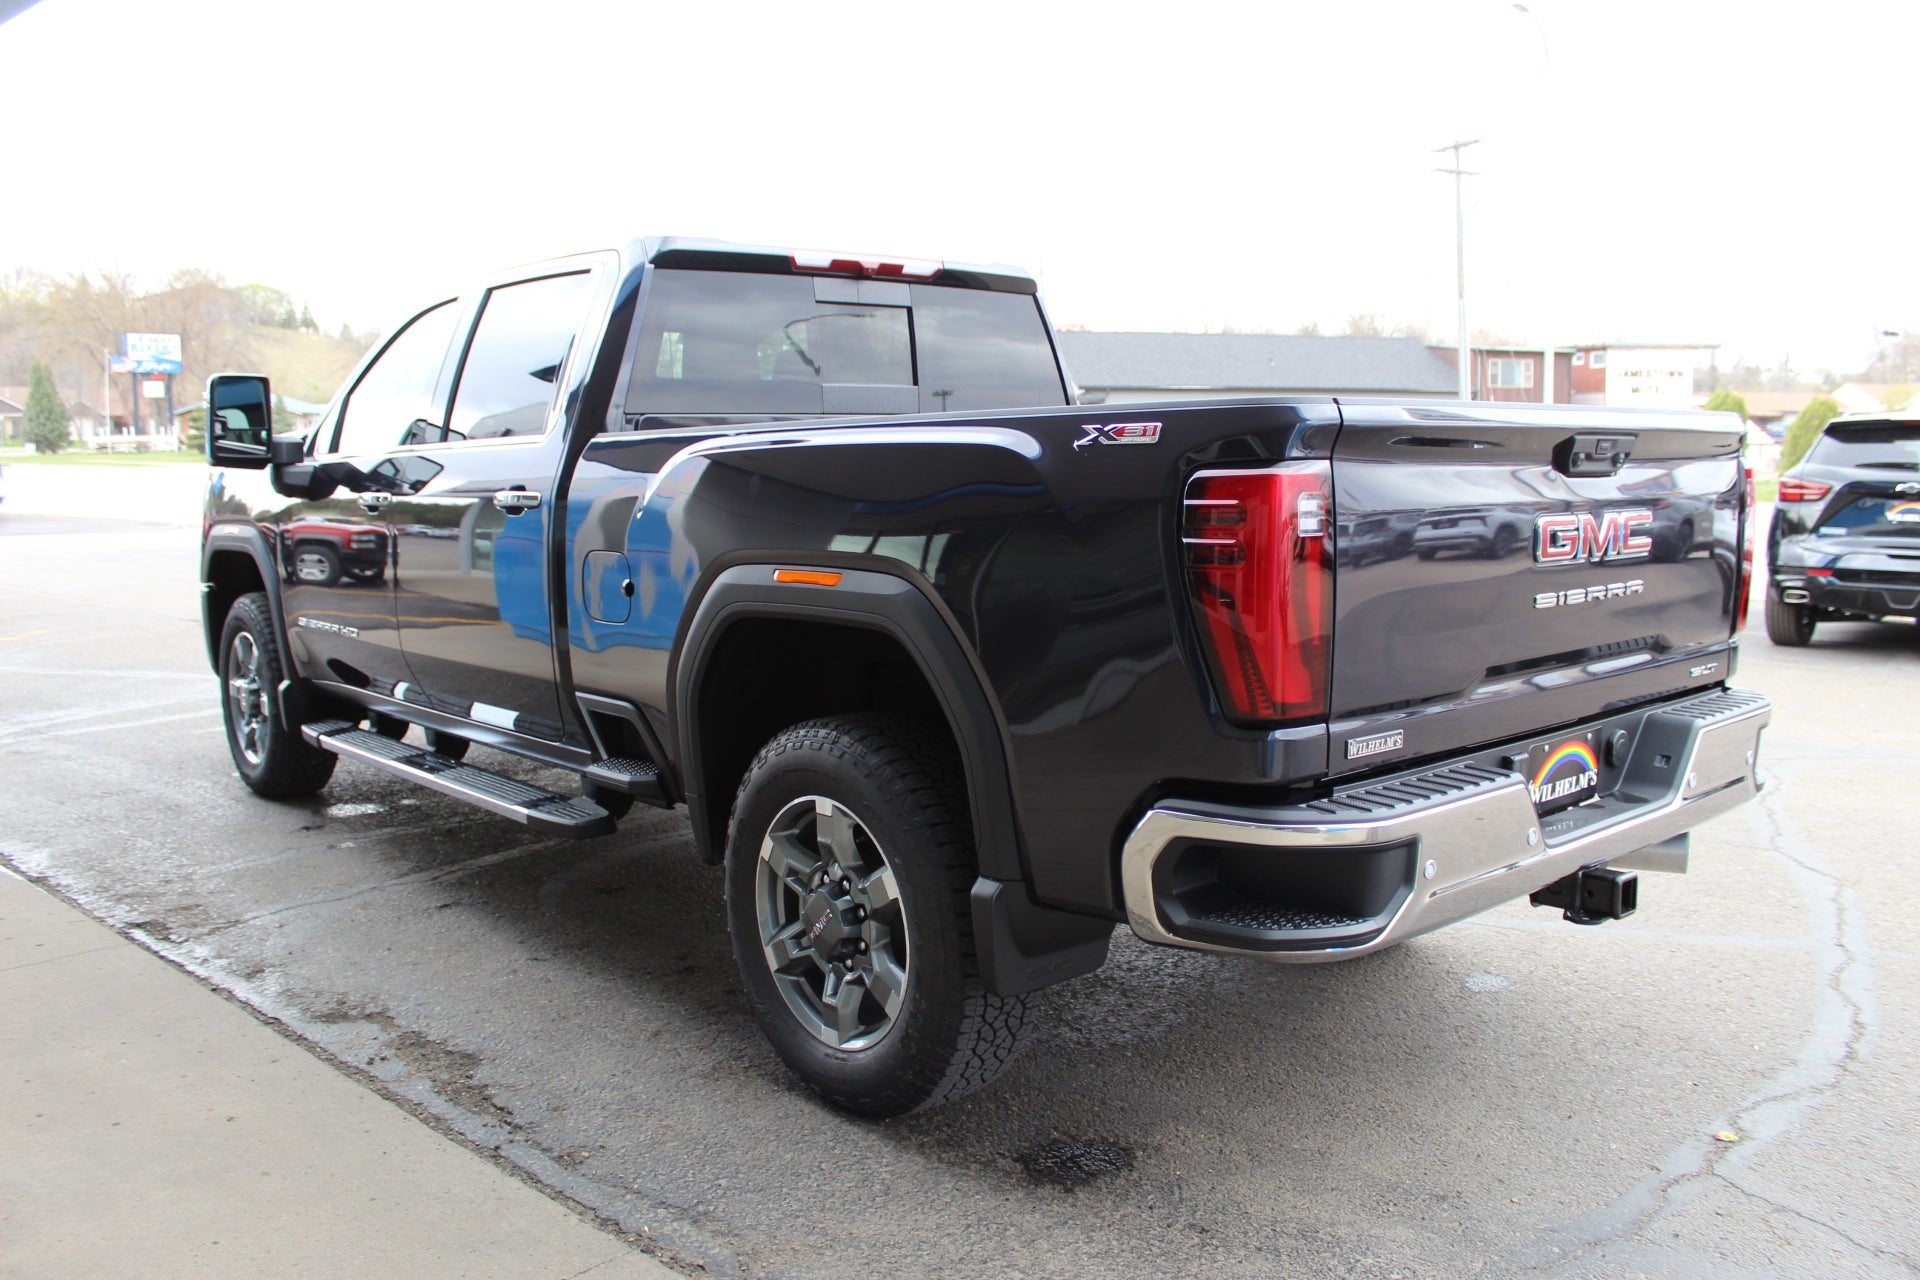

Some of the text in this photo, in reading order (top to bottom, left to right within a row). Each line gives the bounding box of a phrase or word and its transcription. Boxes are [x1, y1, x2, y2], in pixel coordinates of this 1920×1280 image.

[1533, 508, 1653, 568] GMC
[1533, 579, 1645, 609] SIERRA
[298, 616, 360, 638] SIERRA HD
[1690, 662, 1718, 677] SLT
[1350, 735, 1402, 757] WILHELM'S
[1528, 768, 1598, 804] WILHELM'S
[809, 908, 833, 942] GMC
